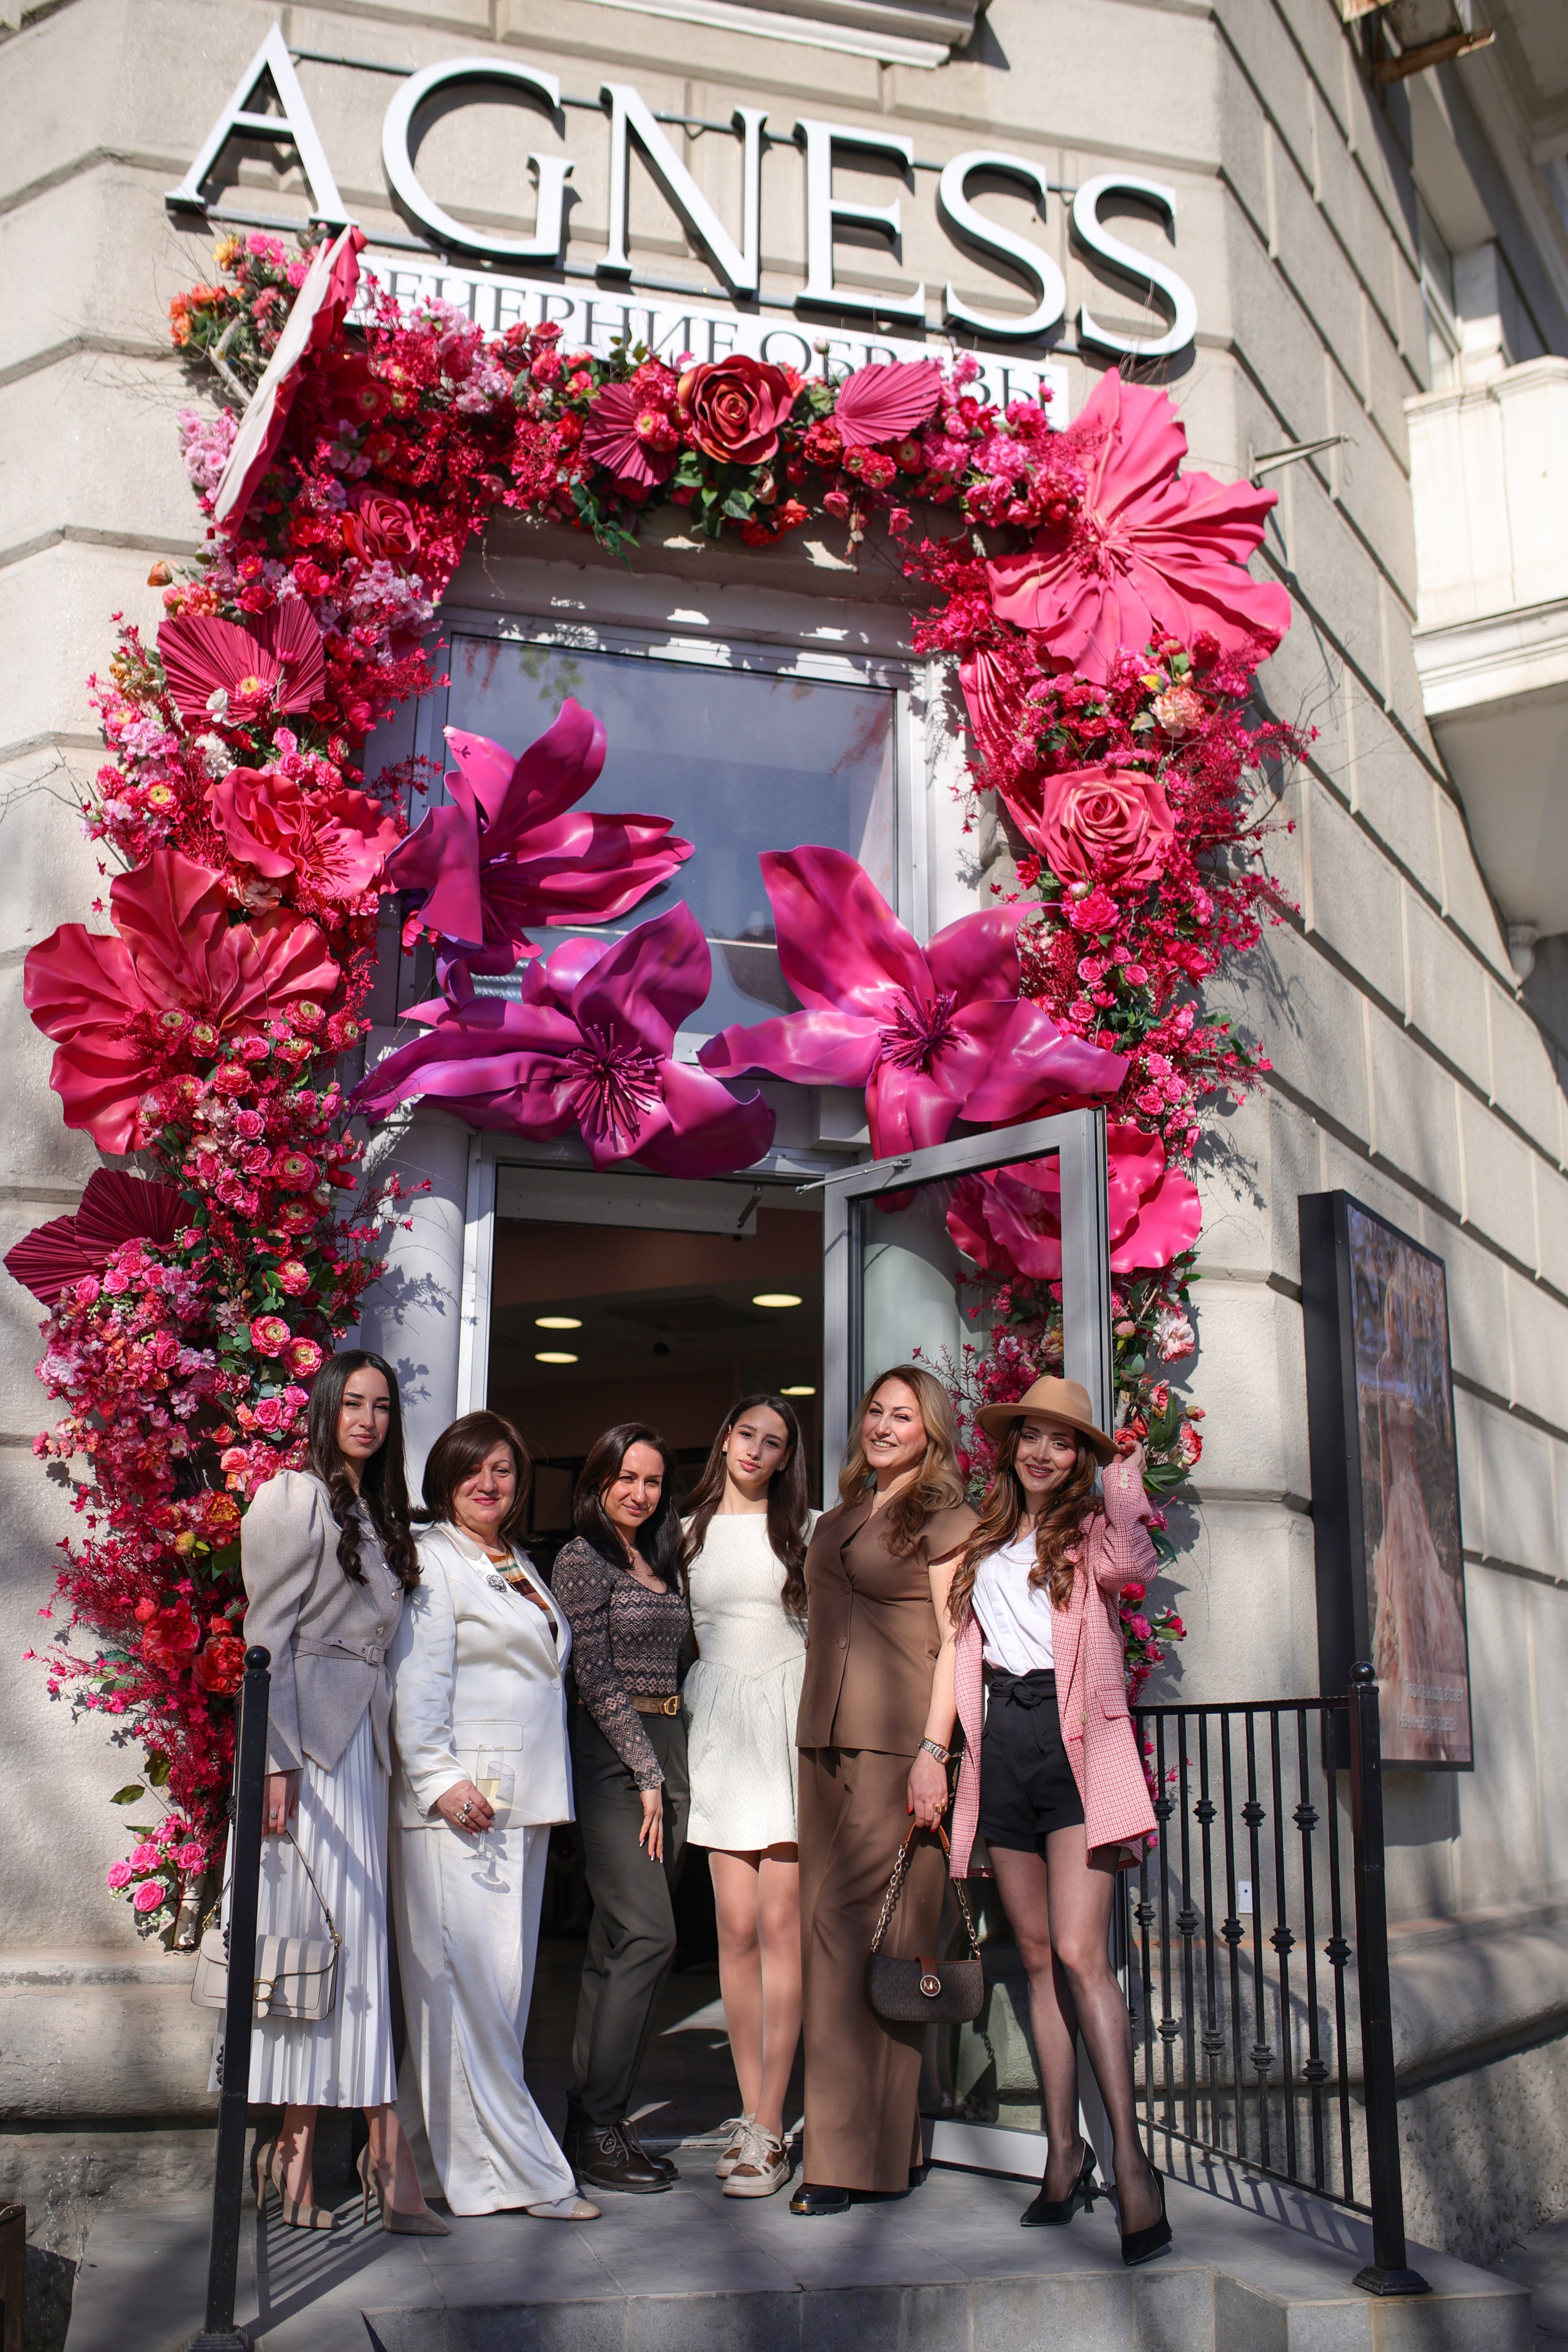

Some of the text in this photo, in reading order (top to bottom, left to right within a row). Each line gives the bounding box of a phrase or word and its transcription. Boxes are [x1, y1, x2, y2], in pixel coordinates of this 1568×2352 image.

[165, 22, 1199, 358] AGNESS
[760, 331, 1052, 419] ОБЗЫ
[924, 1980, 938, 1991] MK
